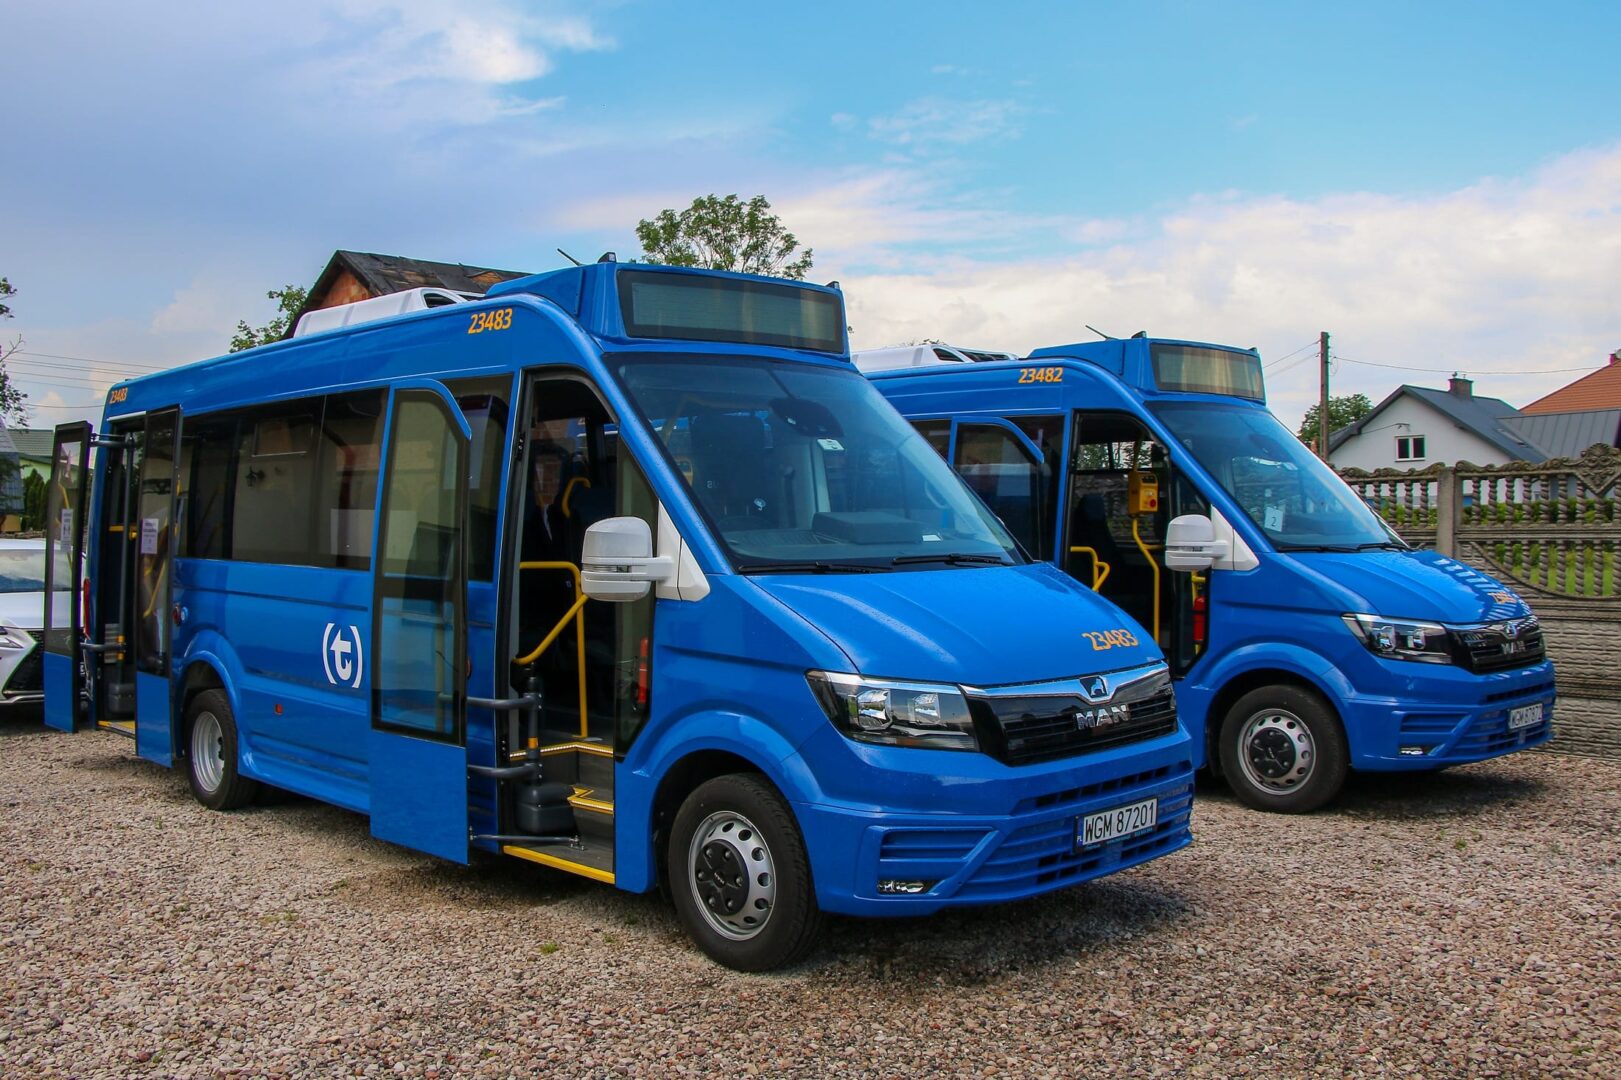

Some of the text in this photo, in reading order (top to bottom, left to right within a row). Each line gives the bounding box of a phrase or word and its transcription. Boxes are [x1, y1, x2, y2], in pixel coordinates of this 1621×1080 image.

[468, 308, 513, 334] 23483
[1018, 367, 1064, 384] 23482
[1081, 628, 1139, 651] 23483
[1075, 704, 1129, 730] MAN
[1085, 813, 1112, 842] WGM
[1116, 802, 1154, 833] 87201
